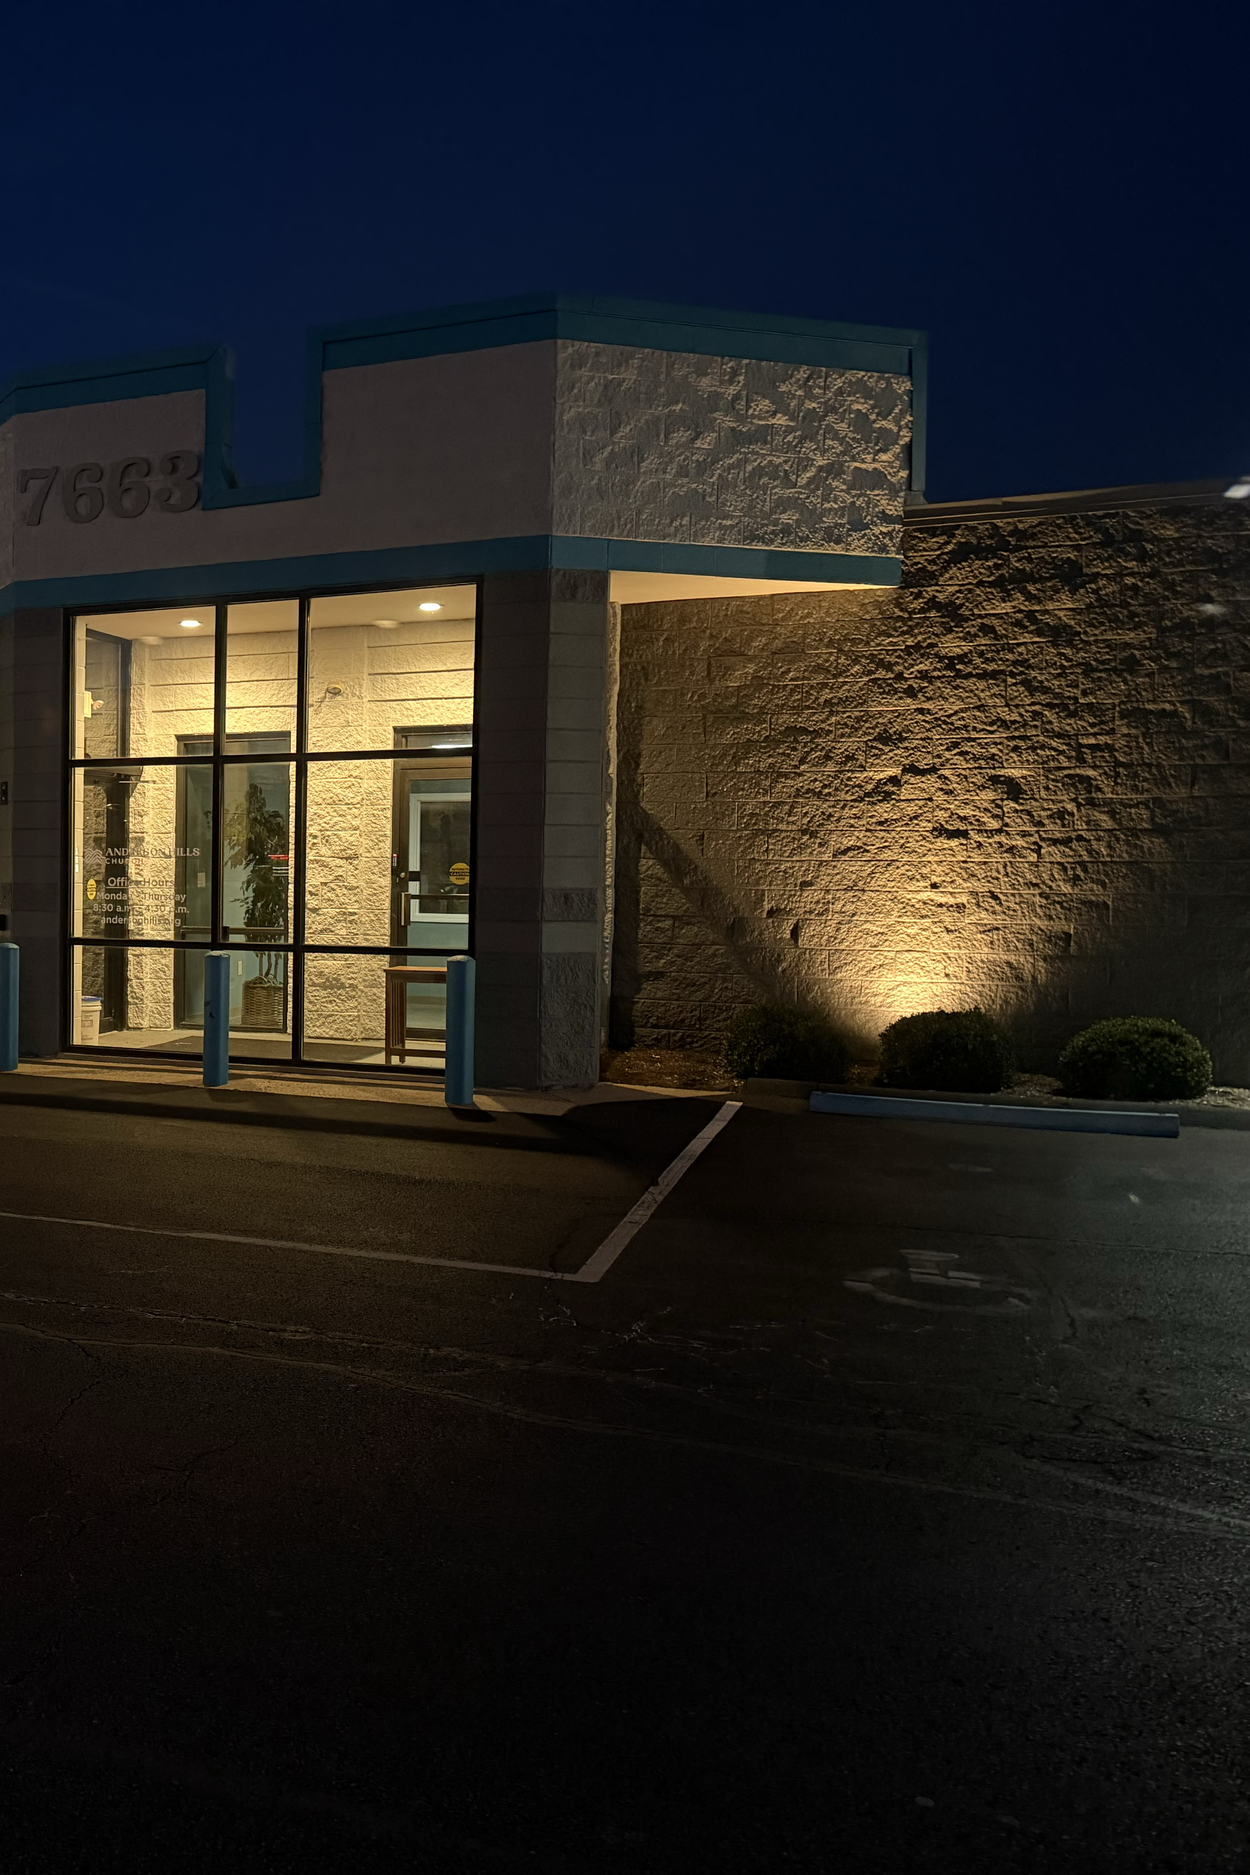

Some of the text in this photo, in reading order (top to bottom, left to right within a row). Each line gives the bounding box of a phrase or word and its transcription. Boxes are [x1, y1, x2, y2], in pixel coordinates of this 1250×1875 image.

[17, 449, 199, 527] 7663
[105, 847, 166, 857] ANDSON
[107, 877, 175, 887] Offic Hours
[96, 892, 134, 902] Monda
[92, 903, 114, 912] 8:30
[116, 905, 137, 913] a.m
[144, 904, 166, 913] 4:30
[100, 915, 181, 926] anderonhills.org
